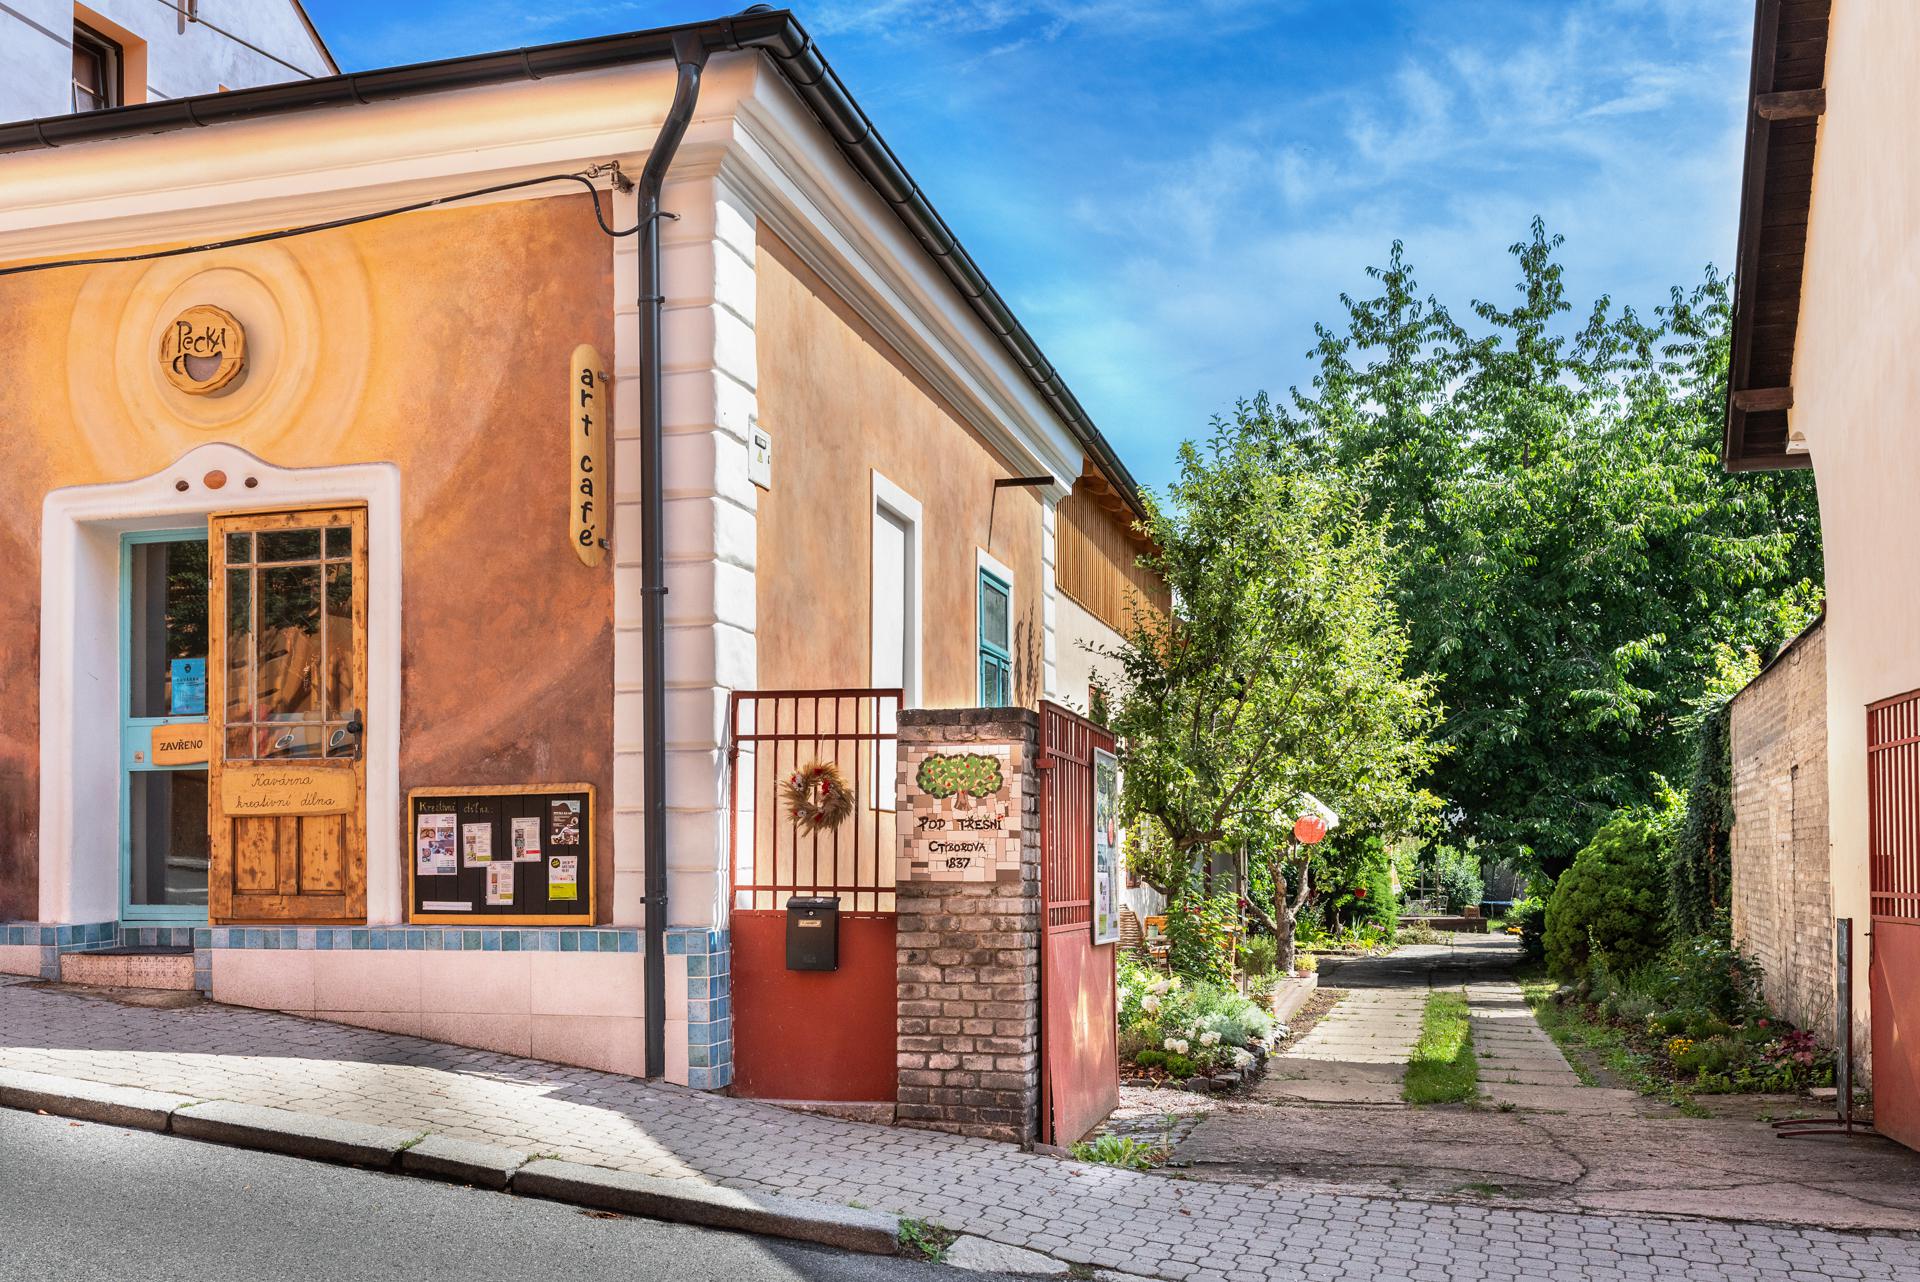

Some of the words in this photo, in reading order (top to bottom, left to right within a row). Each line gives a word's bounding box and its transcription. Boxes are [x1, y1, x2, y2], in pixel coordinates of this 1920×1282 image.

[580, 367, 594, 437] art
[579, 455, 596, 547] café
[159, 738, 203, 752] ZAVŘENO
[251, 773, 314, 787] Kavárna
[235, 793, 292, 809] kreativní
[300, 791, 335, 807] dílna
[917, 816, 946, 831] POD
[945, 857, 971, 870] 1837
